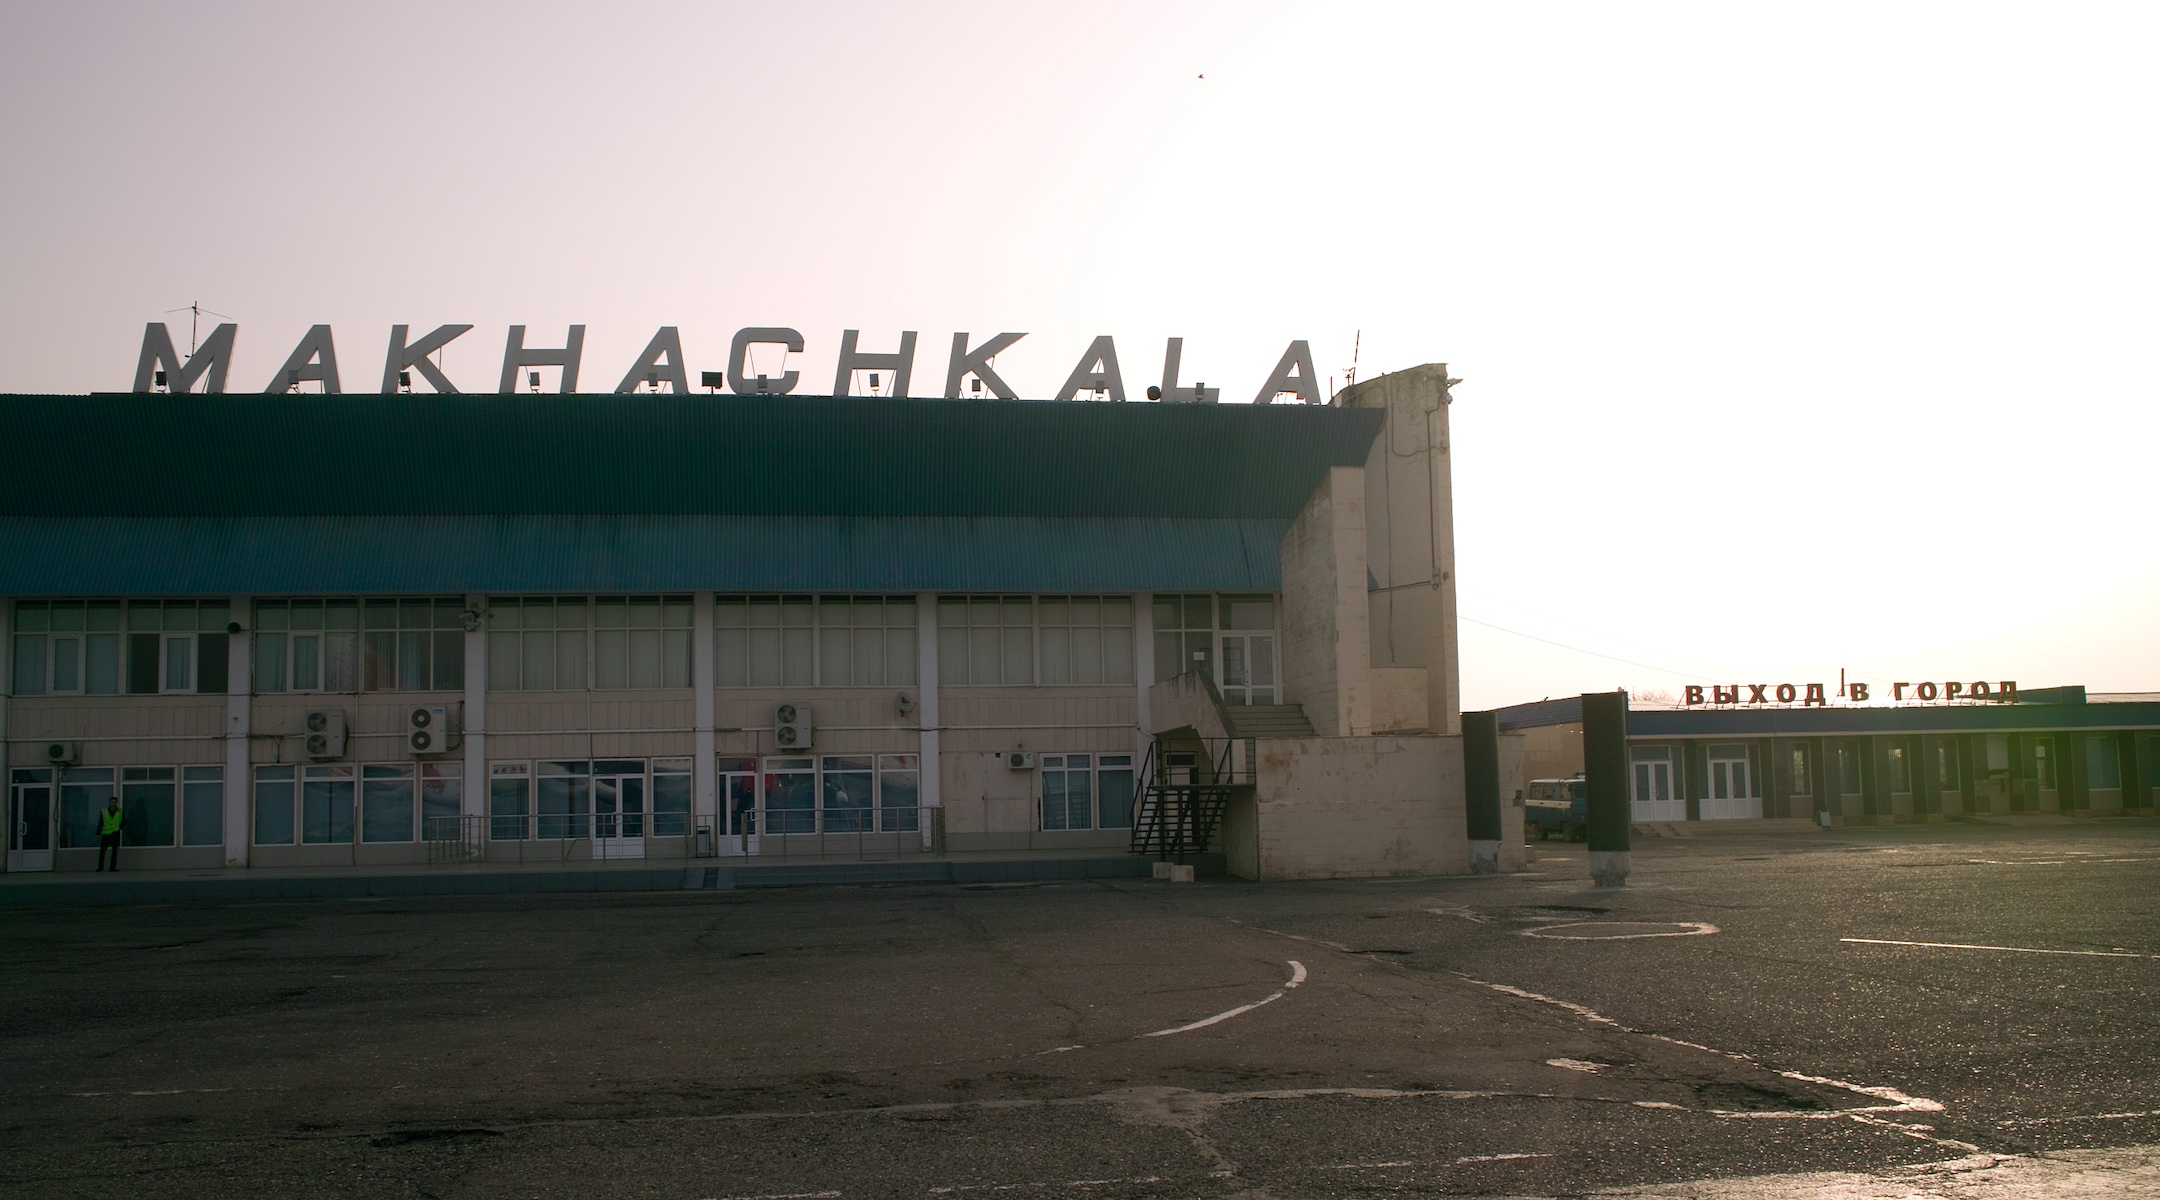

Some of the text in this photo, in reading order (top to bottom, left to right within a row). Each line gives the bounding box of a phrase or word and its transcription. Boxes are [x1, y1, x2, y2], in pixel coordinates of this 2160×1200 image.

[132, 322, 1322, 405] MAKHACHKALA
[1685, 681, 2020, 707] ВЫХОД В ГОРОД
